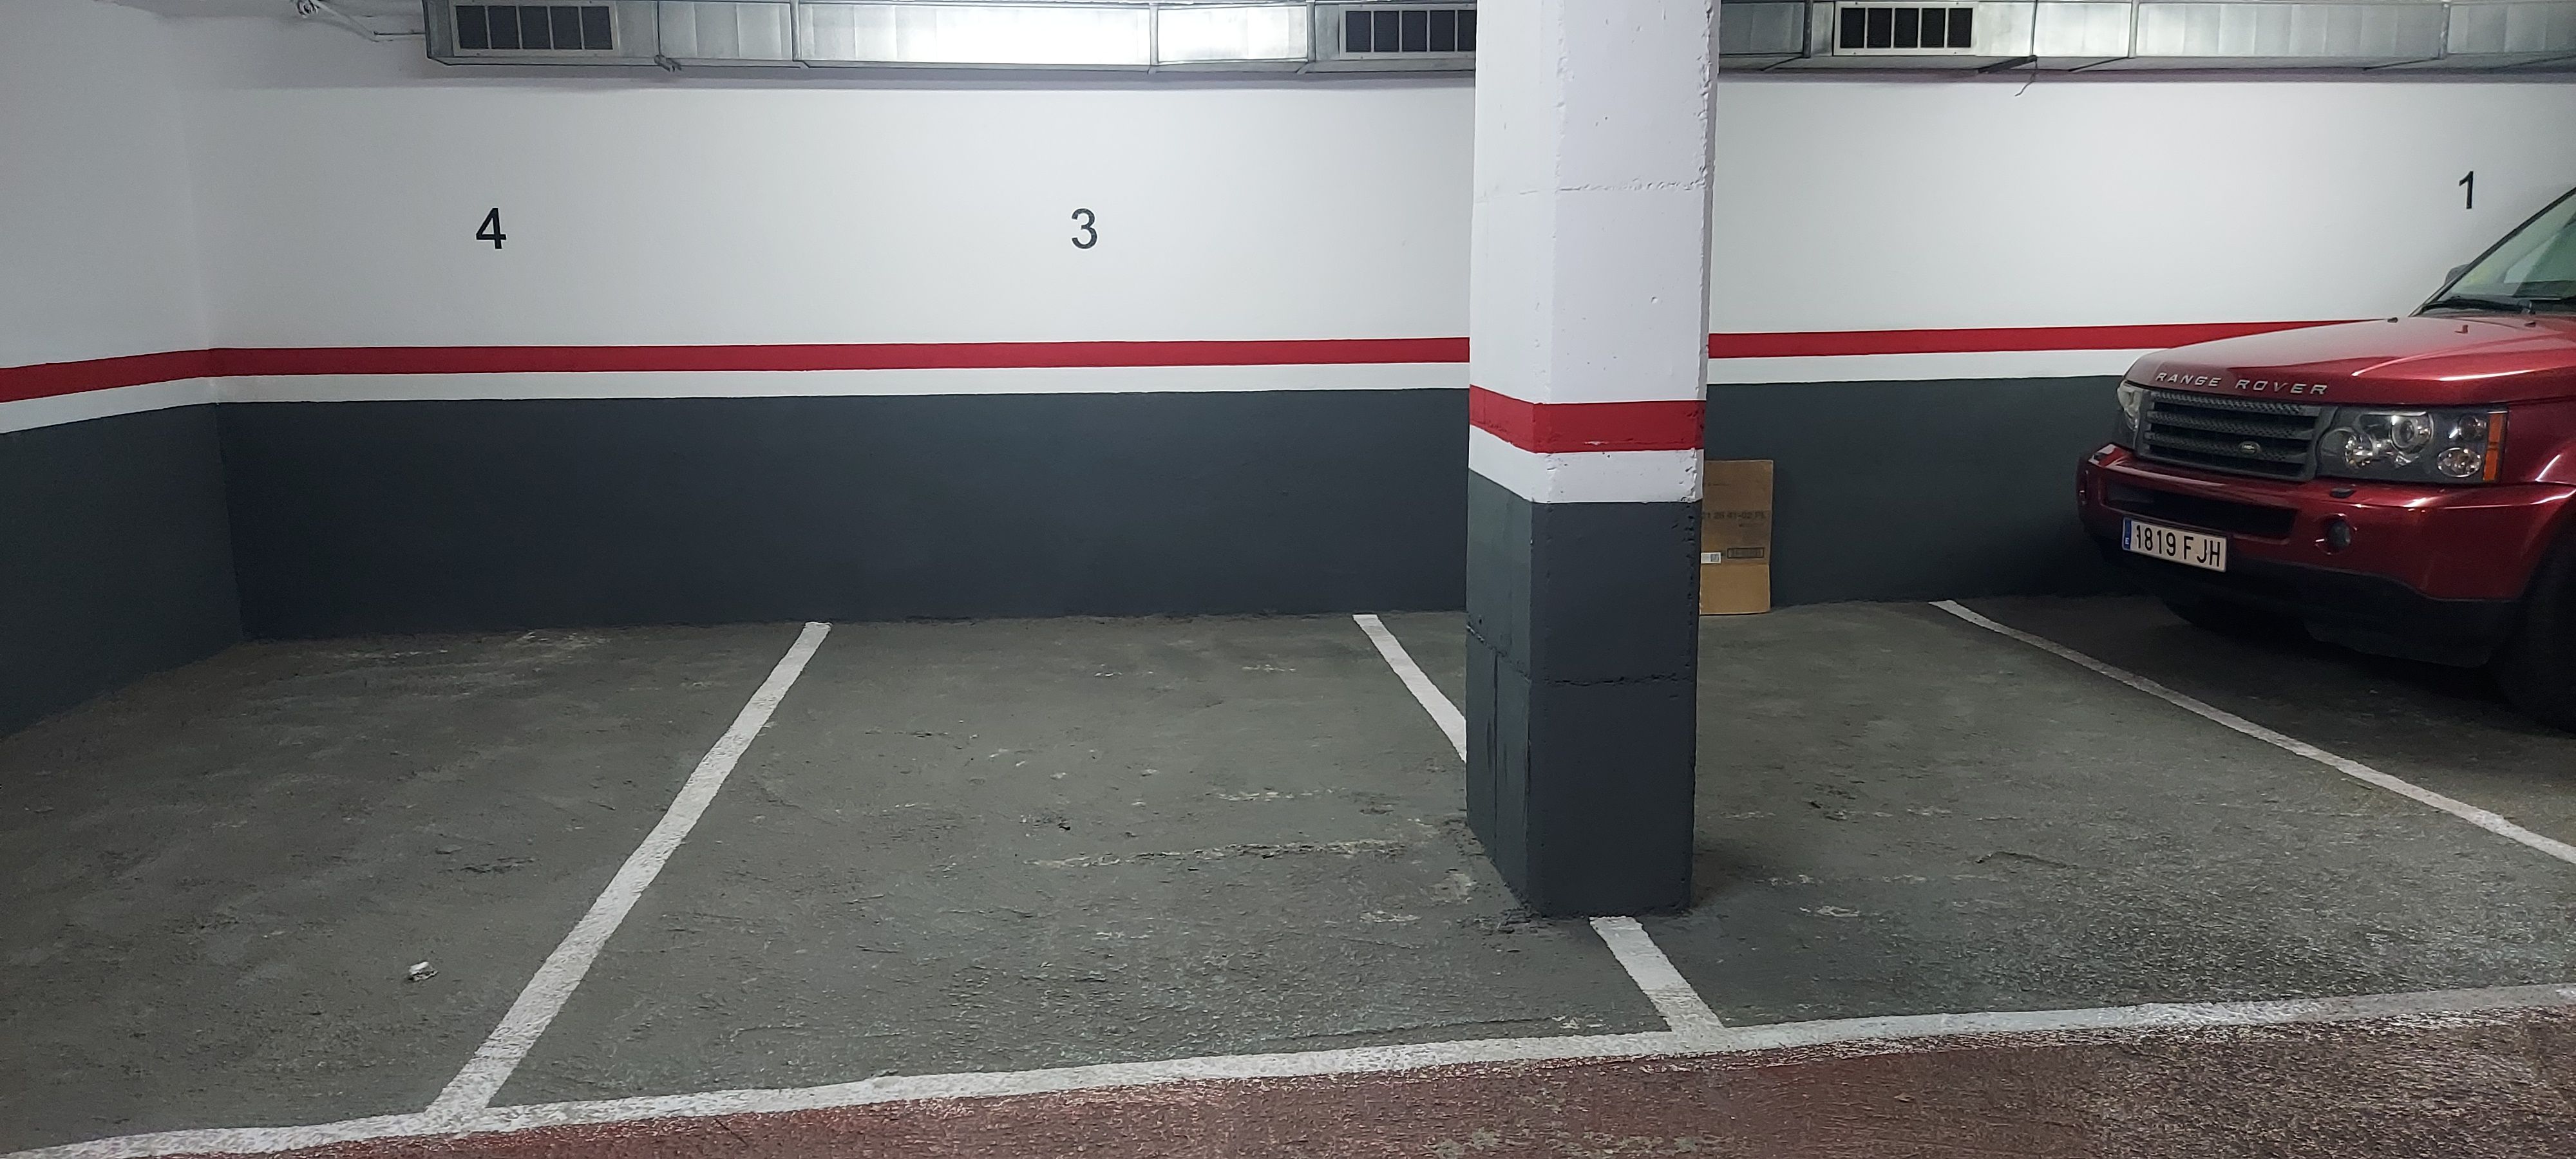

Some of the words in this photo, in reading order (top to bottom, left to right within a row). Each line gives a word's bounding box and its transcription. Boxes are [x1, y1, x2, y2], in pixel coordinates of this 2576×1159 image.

[2459, 171, 2474, 210] 1
[475, 207, 507, 250] 4
[1070, 207, 1099, 250] 3
[2155, 372, 2222, 387] RANGE
[2235, 379, 2329, 395] ROVER
[2125, 537, 2130, 545] E
[2136, 525, 2177, 556] 1819
[2183, 534, 2221, 567] FJH
